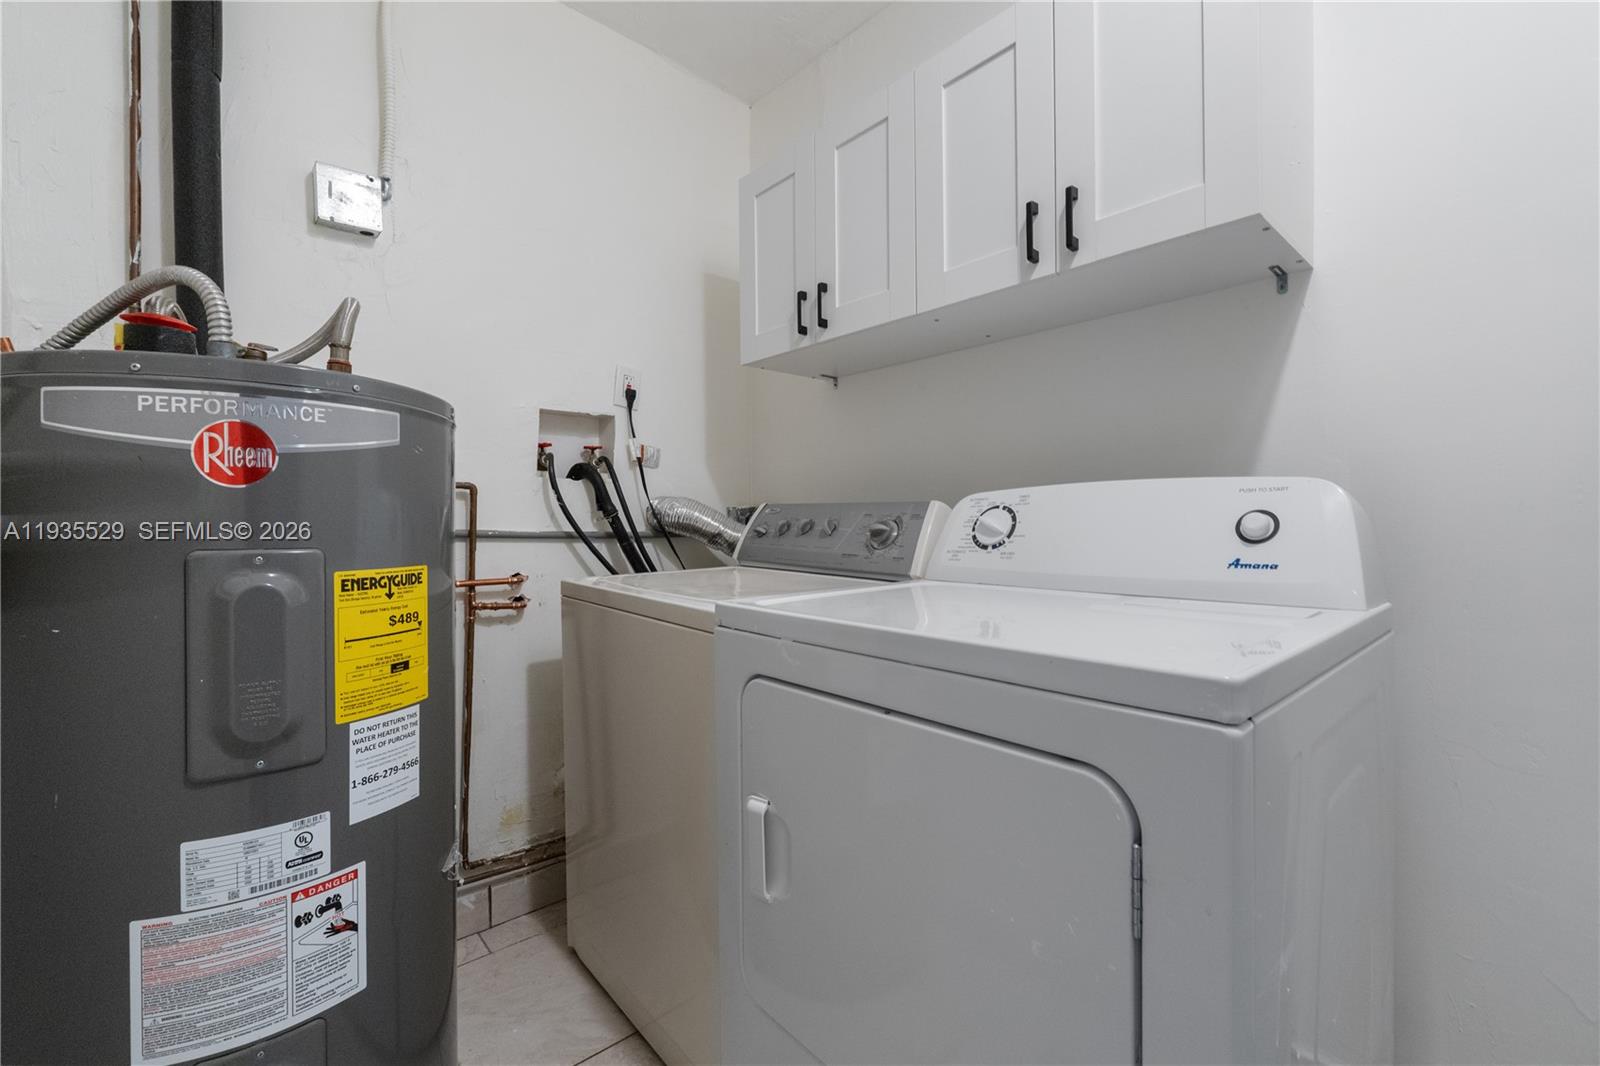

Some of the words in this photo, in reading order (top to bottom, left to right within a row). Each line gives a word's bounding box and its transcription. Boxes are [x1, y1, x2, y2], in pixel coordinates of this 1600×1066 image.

[203, 422, 273, 476] Rheem
[1227, 557, 1279, 570] Amana
[341, 572, 423, 594] ENERGYGUIDE
[389, 611, 419, 627] $489
[352, 733, 376, 746] WATER
[377, 727, 400, 739] HEATER
[401, 723, 409, 731] TO
[409, 720, 418, 728] THE
[353, 727, 365, 736] DO
[367, 722, 381, 732] NOT
[382, 716, 405, 728] RETURN
[406, 712, 418, 720] THIS
[355, 742, 376, 755] PLACE
[378, 740, 387, 748] OF
[388, 730, 416, 745] PURCHASE
[351, 757, 419, 790] 1-866-279-4566
[308, 872, 355, 896] DANGER
[258, 895, 287, 907] CAUTION
[142, 921, 173, 930] WARNING
